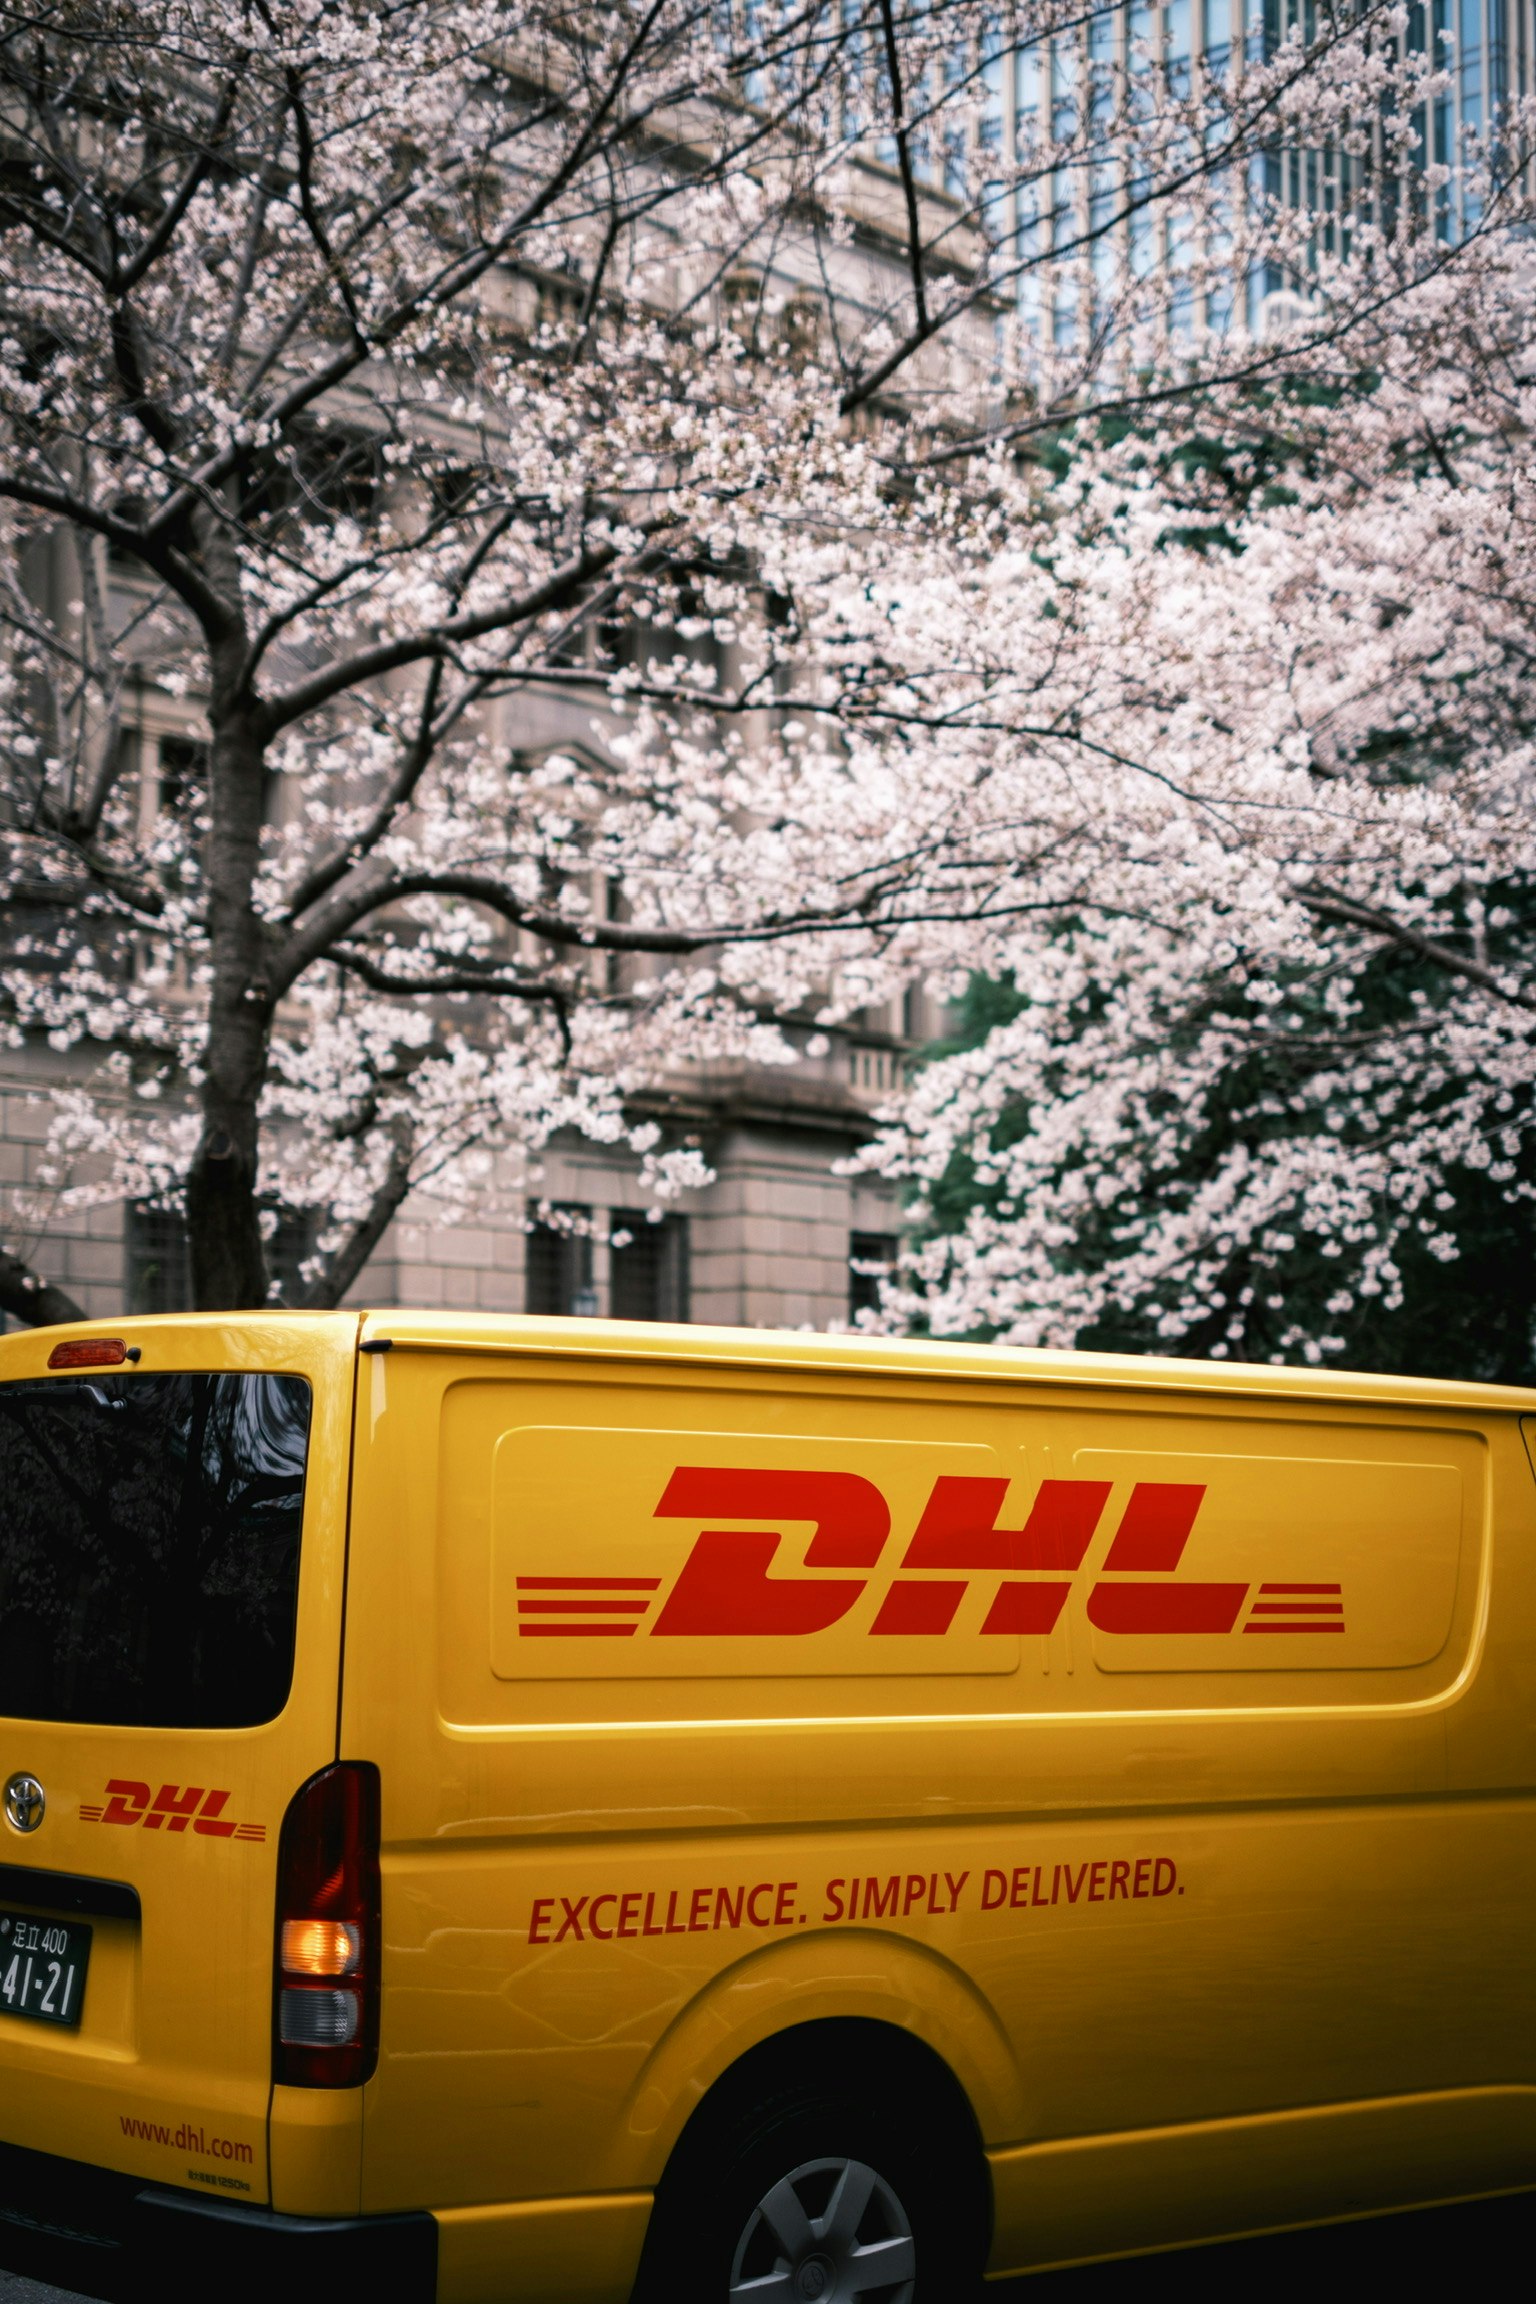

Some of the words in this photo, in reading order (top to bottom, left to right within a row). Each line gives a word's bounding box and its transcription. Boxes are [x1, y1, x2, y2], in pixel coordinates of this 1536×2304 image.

[649, 1466, 1250, 1637] DHL
[101, 1779, 238, 1838] DHL
[528, 1882, 806, 1944] EXCELLENCE.
[822, 1871, 970, 1922] SIMPLY
[980, 1857, 1185, 1911] DELIVERED.
[41, 1927, 68, 1955] 400
[120, 2115, 253, 2164] www.dhl.com
